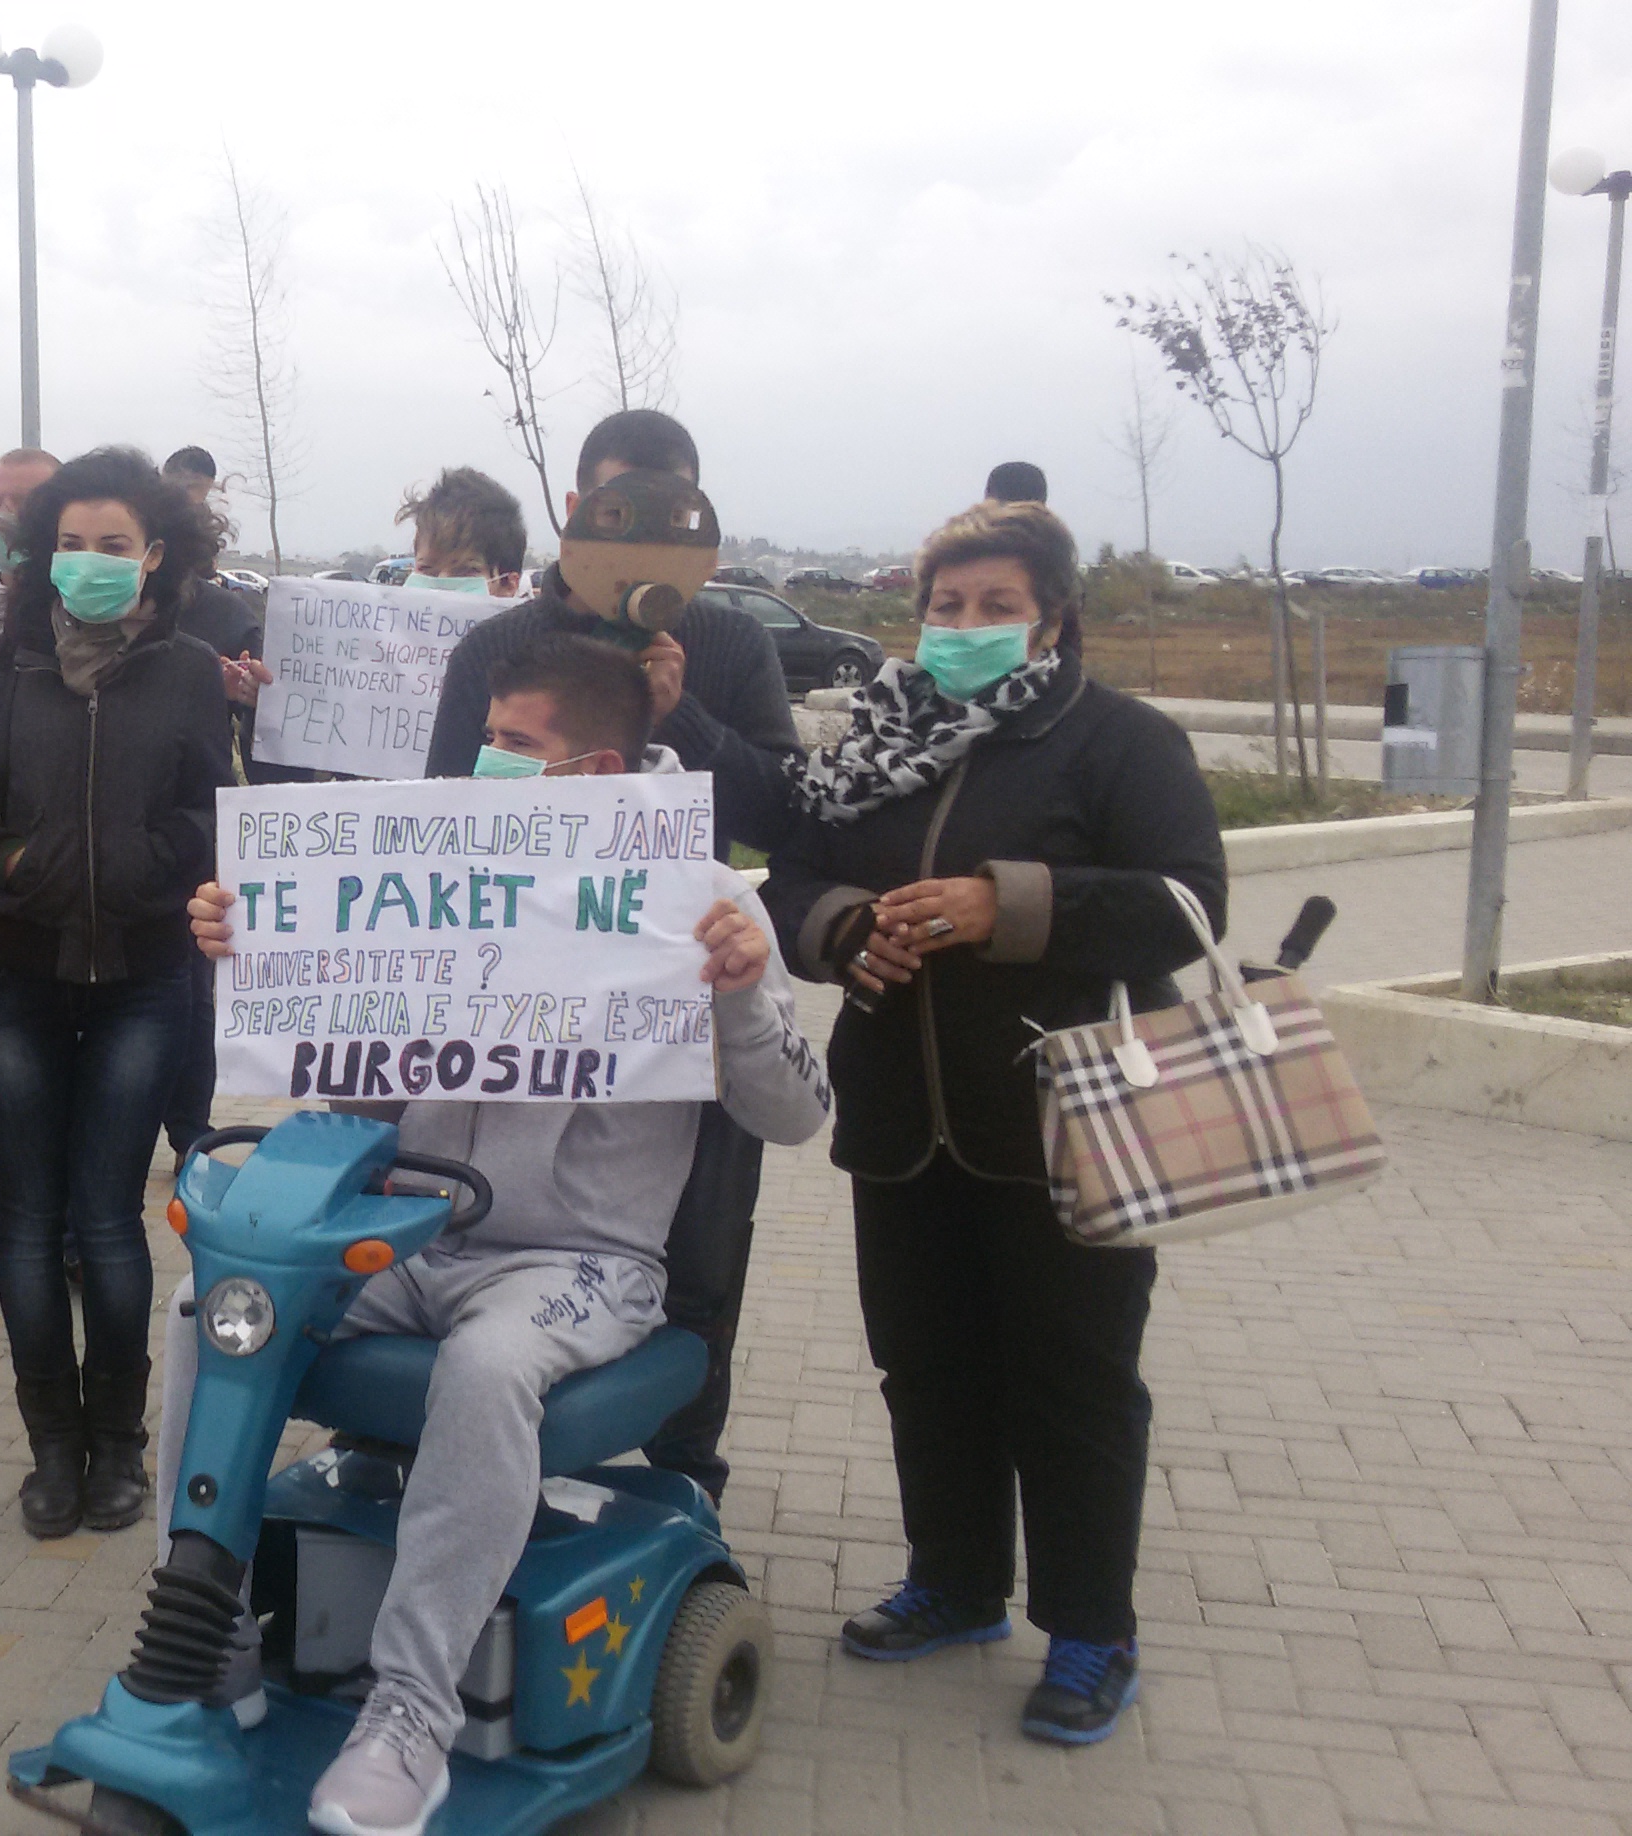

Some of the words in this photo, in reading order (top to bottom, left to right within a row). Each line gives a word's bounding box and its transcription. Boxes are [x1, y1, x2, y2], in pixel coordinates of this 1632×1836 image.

[291, 596, 401, 633] TUMORRET
[407, 606, 432, 632] NË
[292, 633, 324, 655] DHE
[279, 658, 407, 694] FALEMINDERIT
[279, 688, 347, 746] PËR
[238, 811, 360, 860] PERSE
[372, 804, 589, 859] INVALIDËT
[594, 798, 711, 862] JANË
[238, 871, 298, 932] TË
[334, 865, 536, 935] PAKËT
[575, 868, 649, 935] NË
[231, 948, 457, 992] UNIVERSITETE
[477, 942, 503, 991] ?
[224, 995, 322, 1039] SEPSE
[327, 990, 411, 1037] LIRIA
[421, 993, 452, 1037] E
[467, 992, 587, 1044] TYRE
[604, 991, 712, 1044] ËSHTË
[289, 1038, 617, 1100] BURGOSUR!
